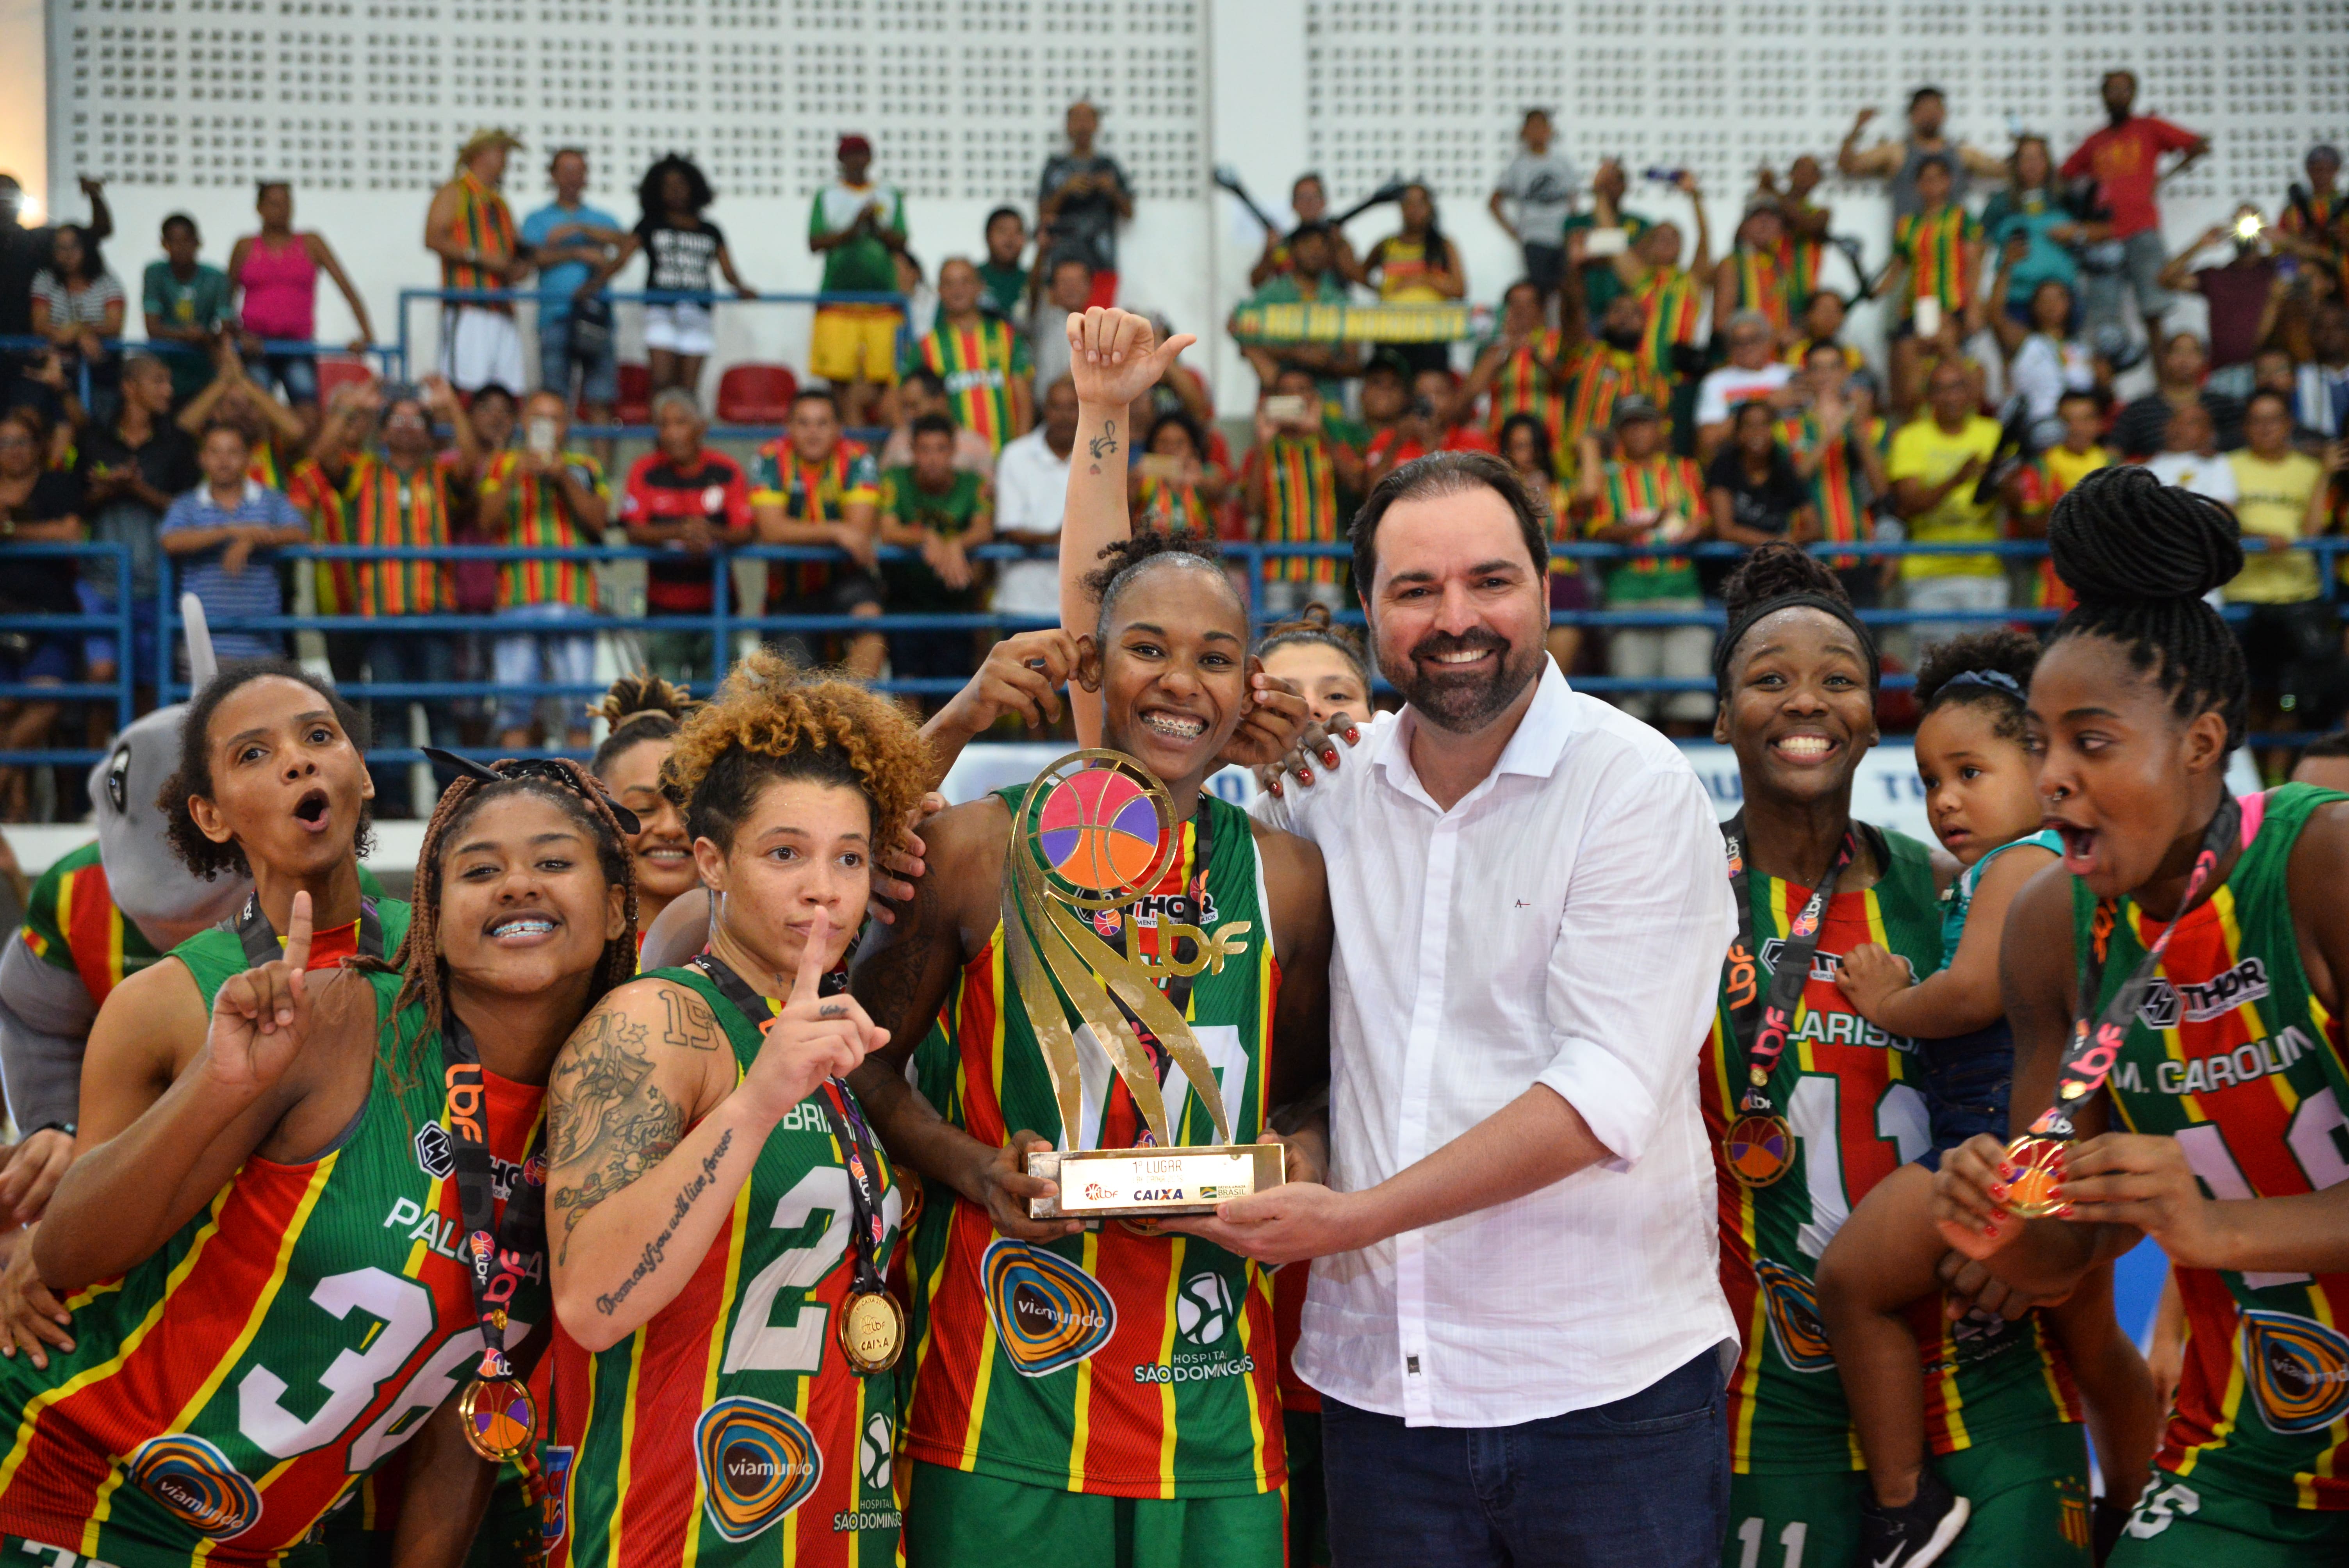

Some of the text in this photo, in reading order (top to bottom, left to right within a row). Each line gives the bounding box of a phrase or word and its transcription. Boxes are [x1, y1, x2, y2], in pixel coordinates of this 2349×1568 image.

[1147, 1160, 1182, 1173] LUGAR
[1134, 1189, 1183, 1201] CAIXA
[861, 1297, 875, 1306] CAIXA
[876, 1299, 888, 1309] 2019
[1017, 1297, 1107, 1329] viamundo
[861, 1337, 889, 1351] CAIXA
[1134, 1363, 1171, 1383] SÃO
[728, 1458, 813, 1476] viamundo
[158, 1480, 245, 1530] viamundo
[860, 1499, 892, 1510] HOSPITAL
[834, 1511, 857, 1531] SÃO
[1738, 1517, 1807, 1568] 11
